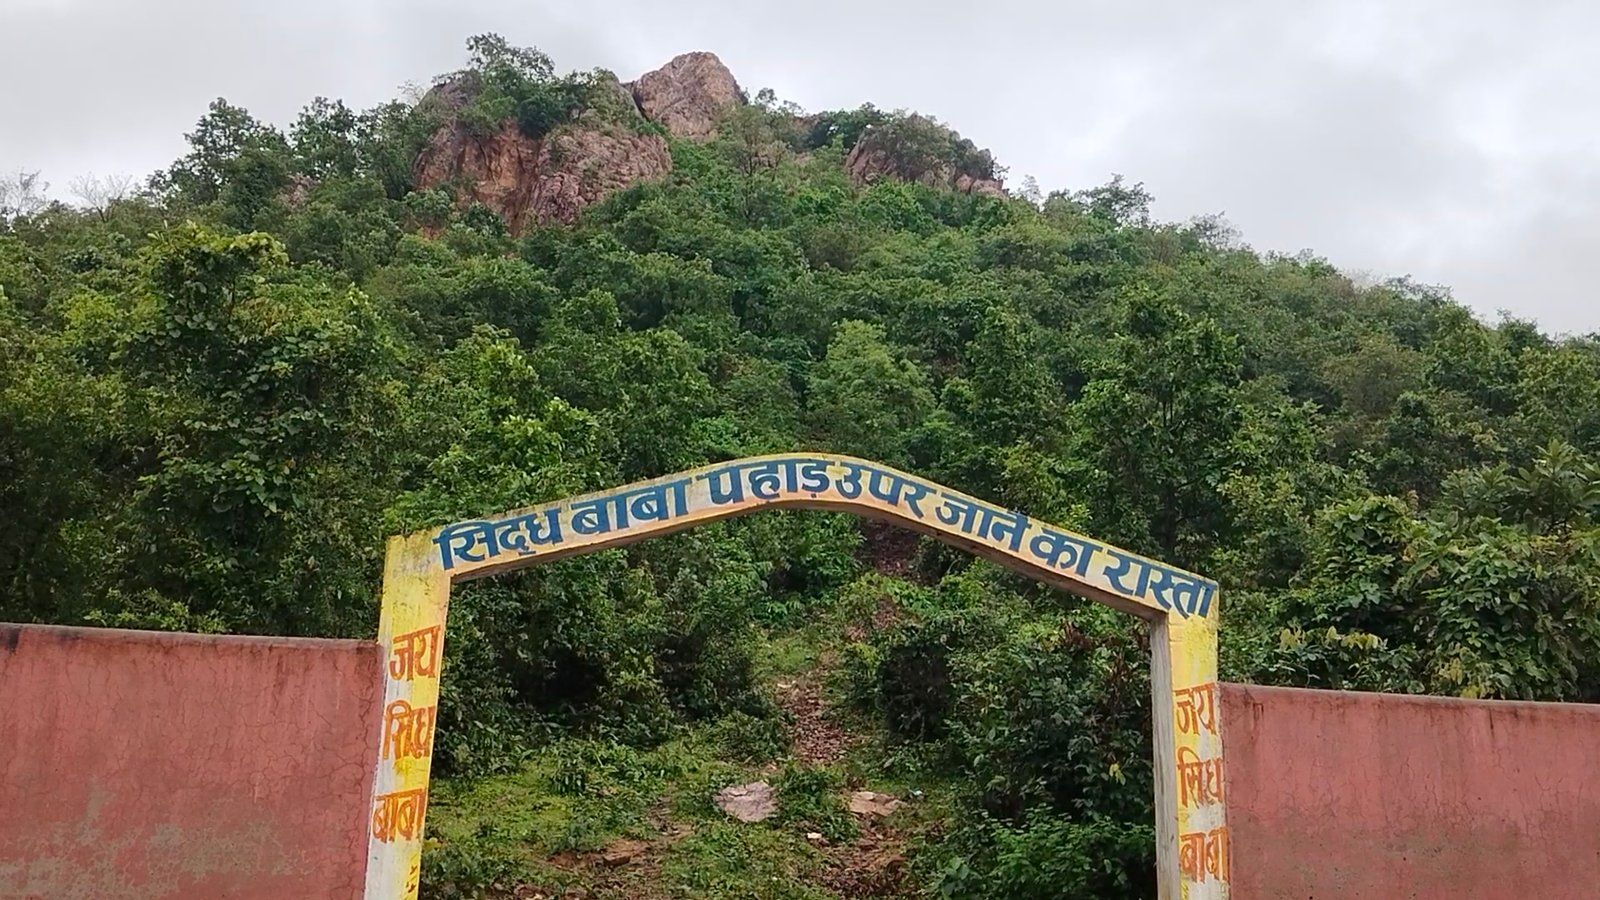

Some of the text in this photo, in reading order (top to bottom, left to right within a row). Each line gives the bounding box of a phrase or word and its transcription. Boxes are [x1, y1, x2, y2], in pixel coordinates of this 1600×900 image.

[571, 477, 693, 534] बाबा
[834, 461, 937, 519] उपर
[935, 490, 1032, 552] जाने
[1029, 527, 1103, 577] का
[1103, 549, 1218, 620] रास्ता
[389, 624, 441, 682] जय
[1175, 682, 1216, 735] जय
[373, 788, 426, 843] बाबा
[1179, 825, 1229, 884] बाबा
